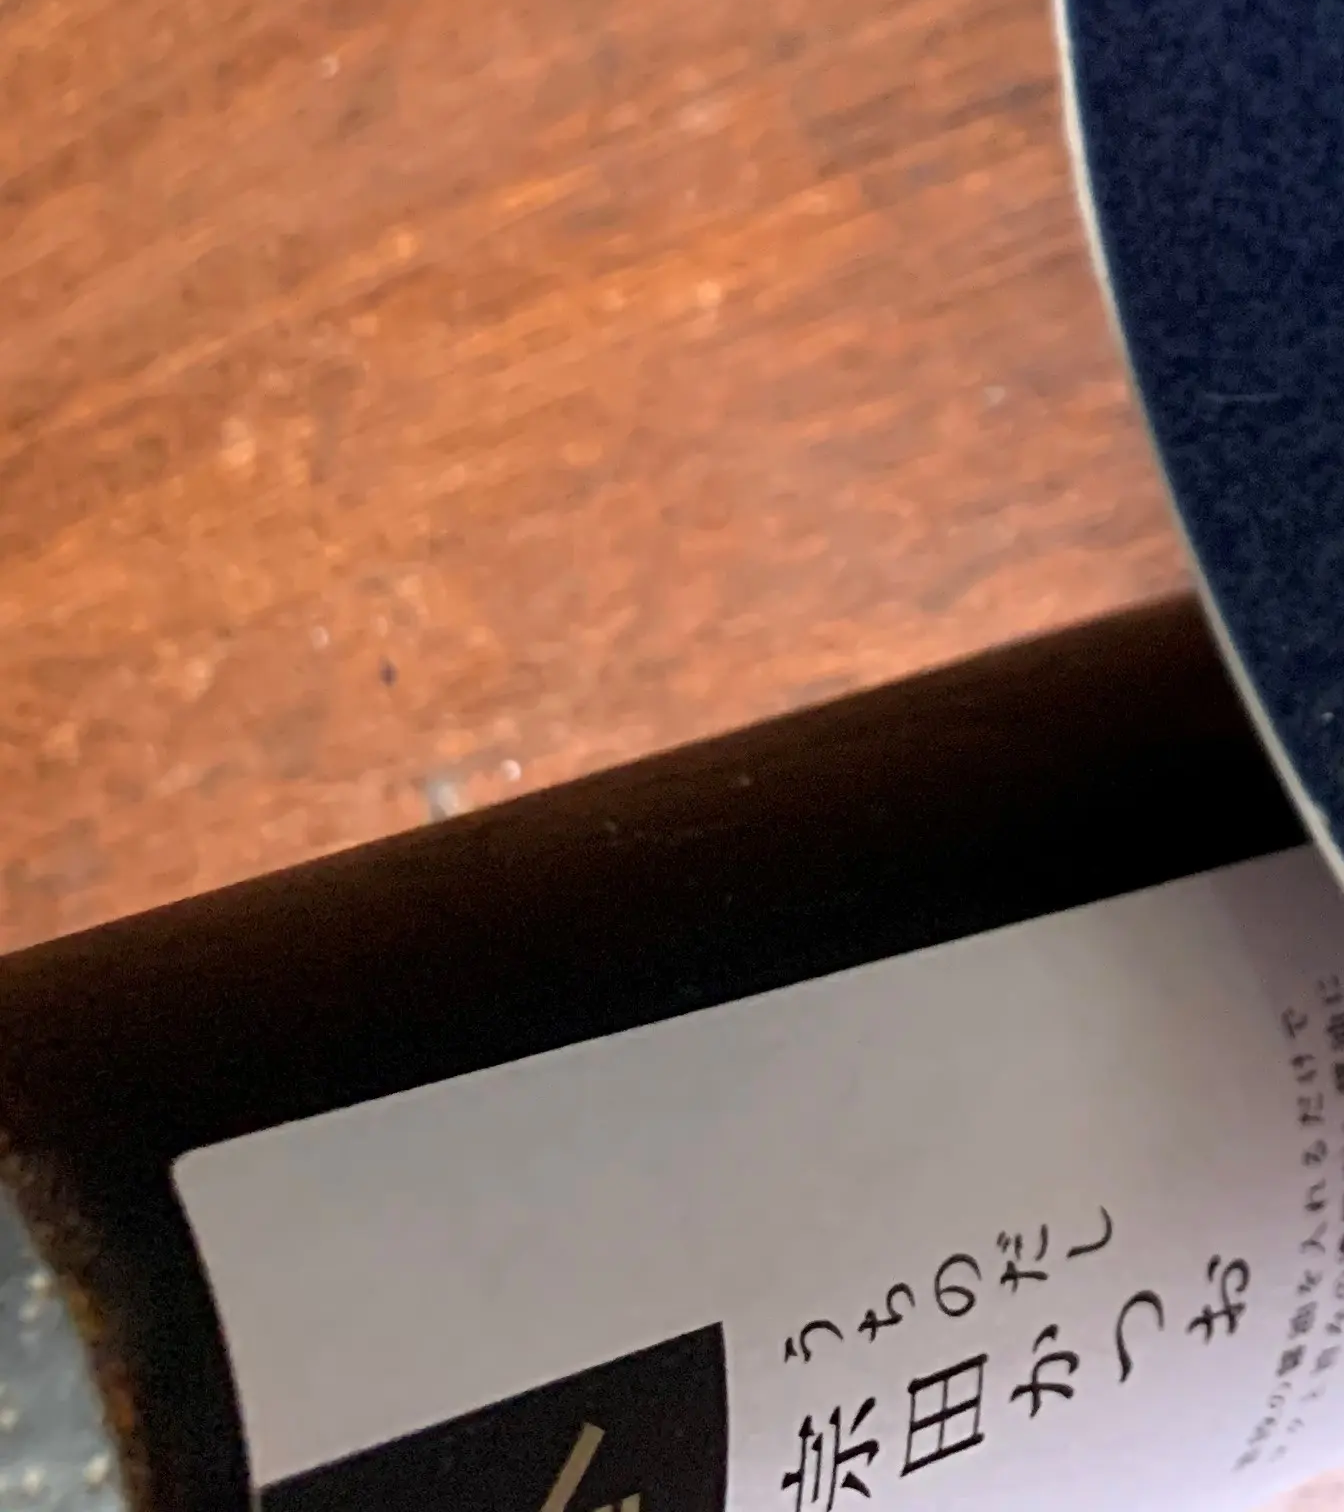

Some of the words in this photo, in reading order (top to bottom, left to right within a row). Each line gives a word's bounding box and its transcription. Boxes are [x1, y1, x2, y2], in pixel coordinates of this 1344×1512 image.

[781, 1254, 1251, 1512] 宗田かつお
[784, 1205, 1113, 1364] うちのだし
